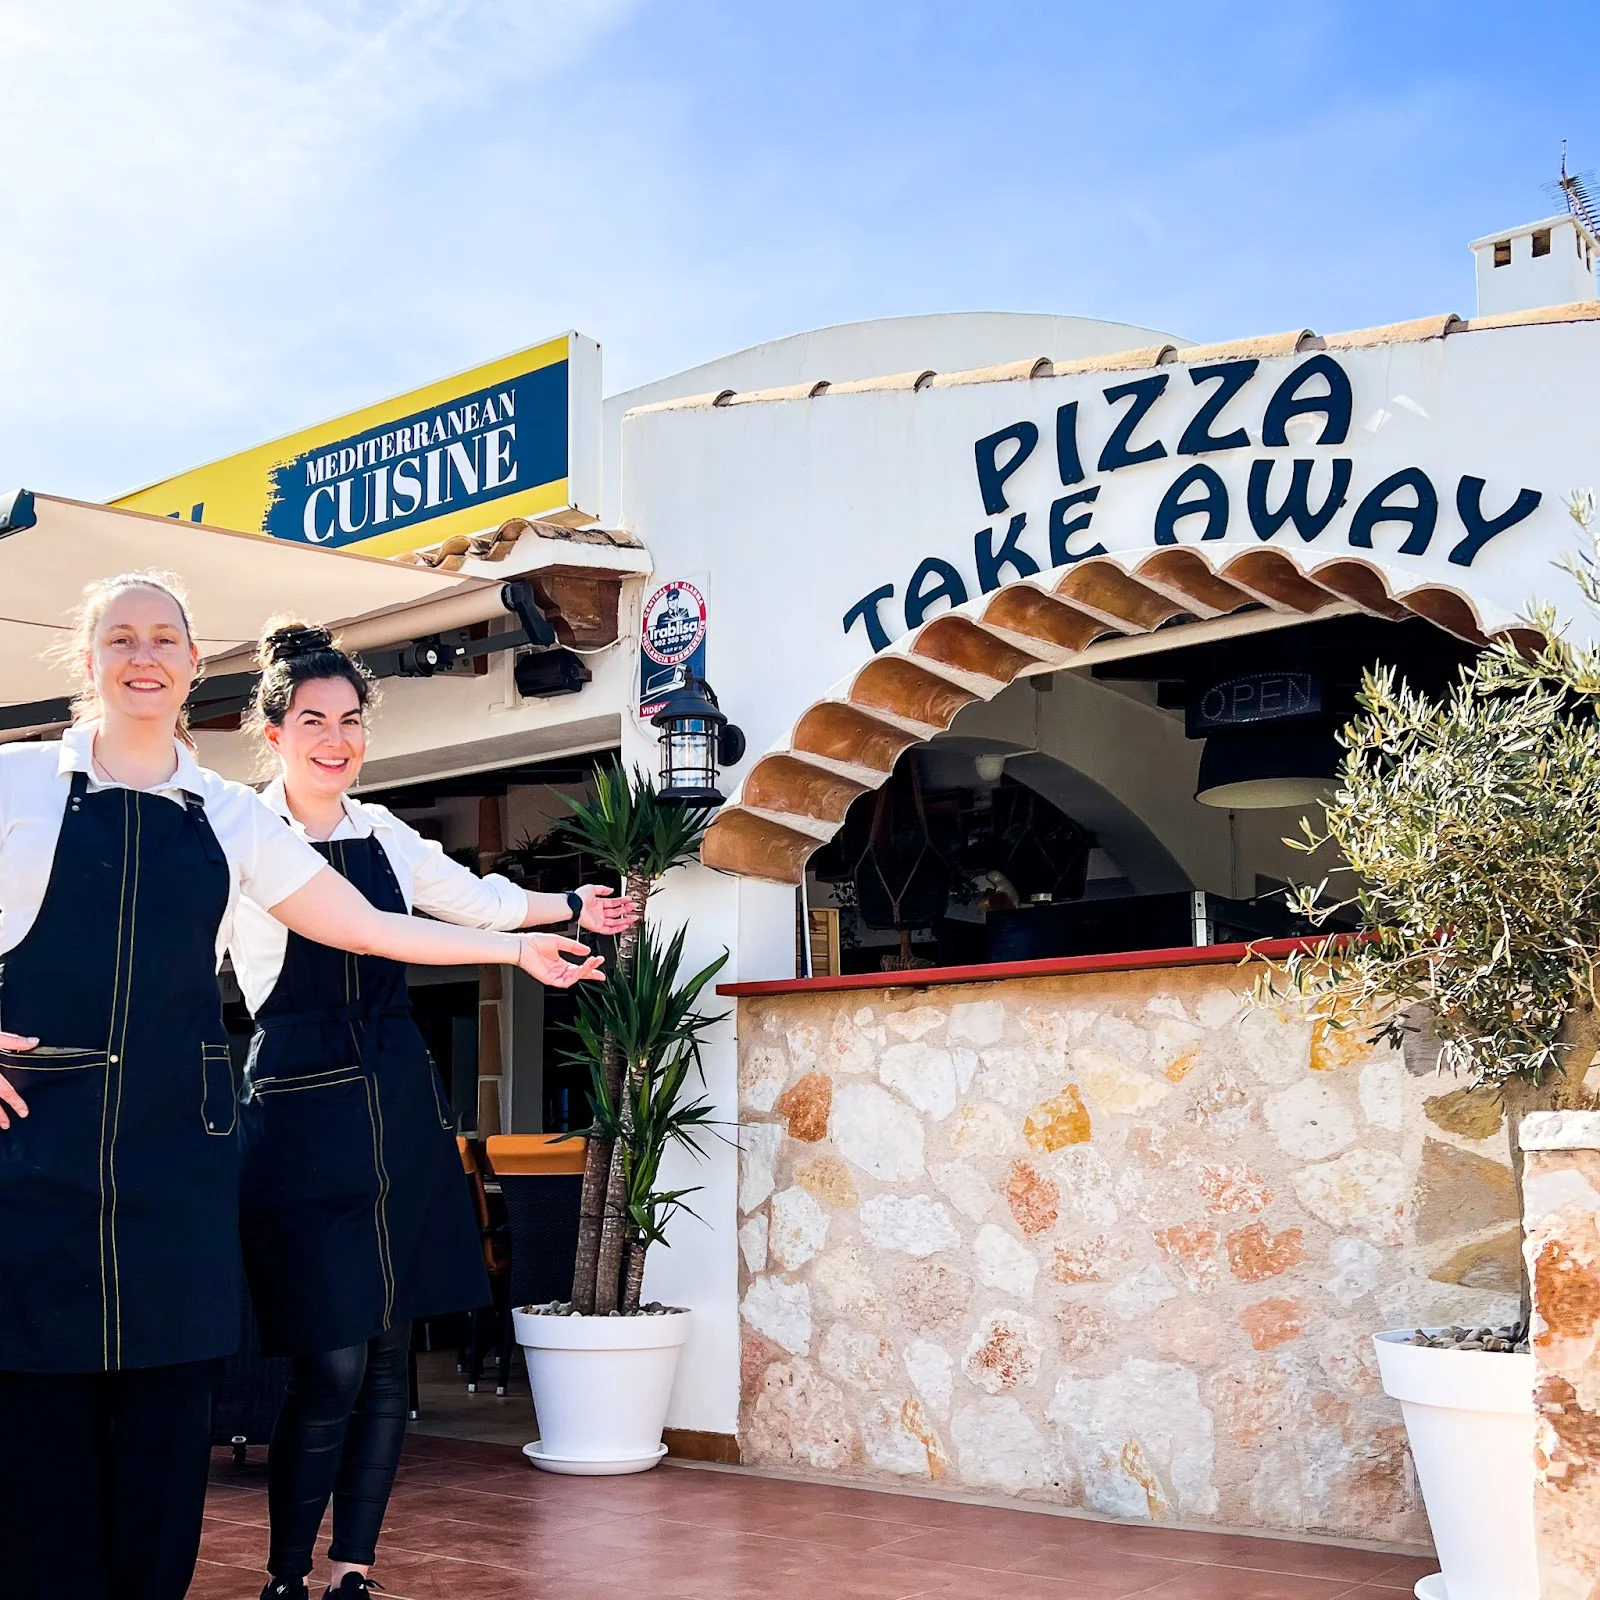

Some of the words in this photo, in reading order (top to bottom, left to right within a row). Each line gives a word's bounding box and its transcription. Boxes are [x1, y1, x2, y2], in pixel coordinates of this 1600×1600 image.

[305, 389, 517, 487] MEDITERRANEAN
[974, 354, 1353, 515] PIZZA
[303, 423, 518, 544] CUISINE
[843, 485, 1109, 653] TAKE
[1154, 458, 1542, 567] AWAY
[643, 587, 668, 619] CENTRAL
[670, 582, 679, 590] DE
[648, 620, 698, 641] Trablisa
[642, 632, 670, 664] VIGILANCIA
[670, 619, 706, 663] PERMANENTE
[1201, 674, 1312, 720] OPEN
